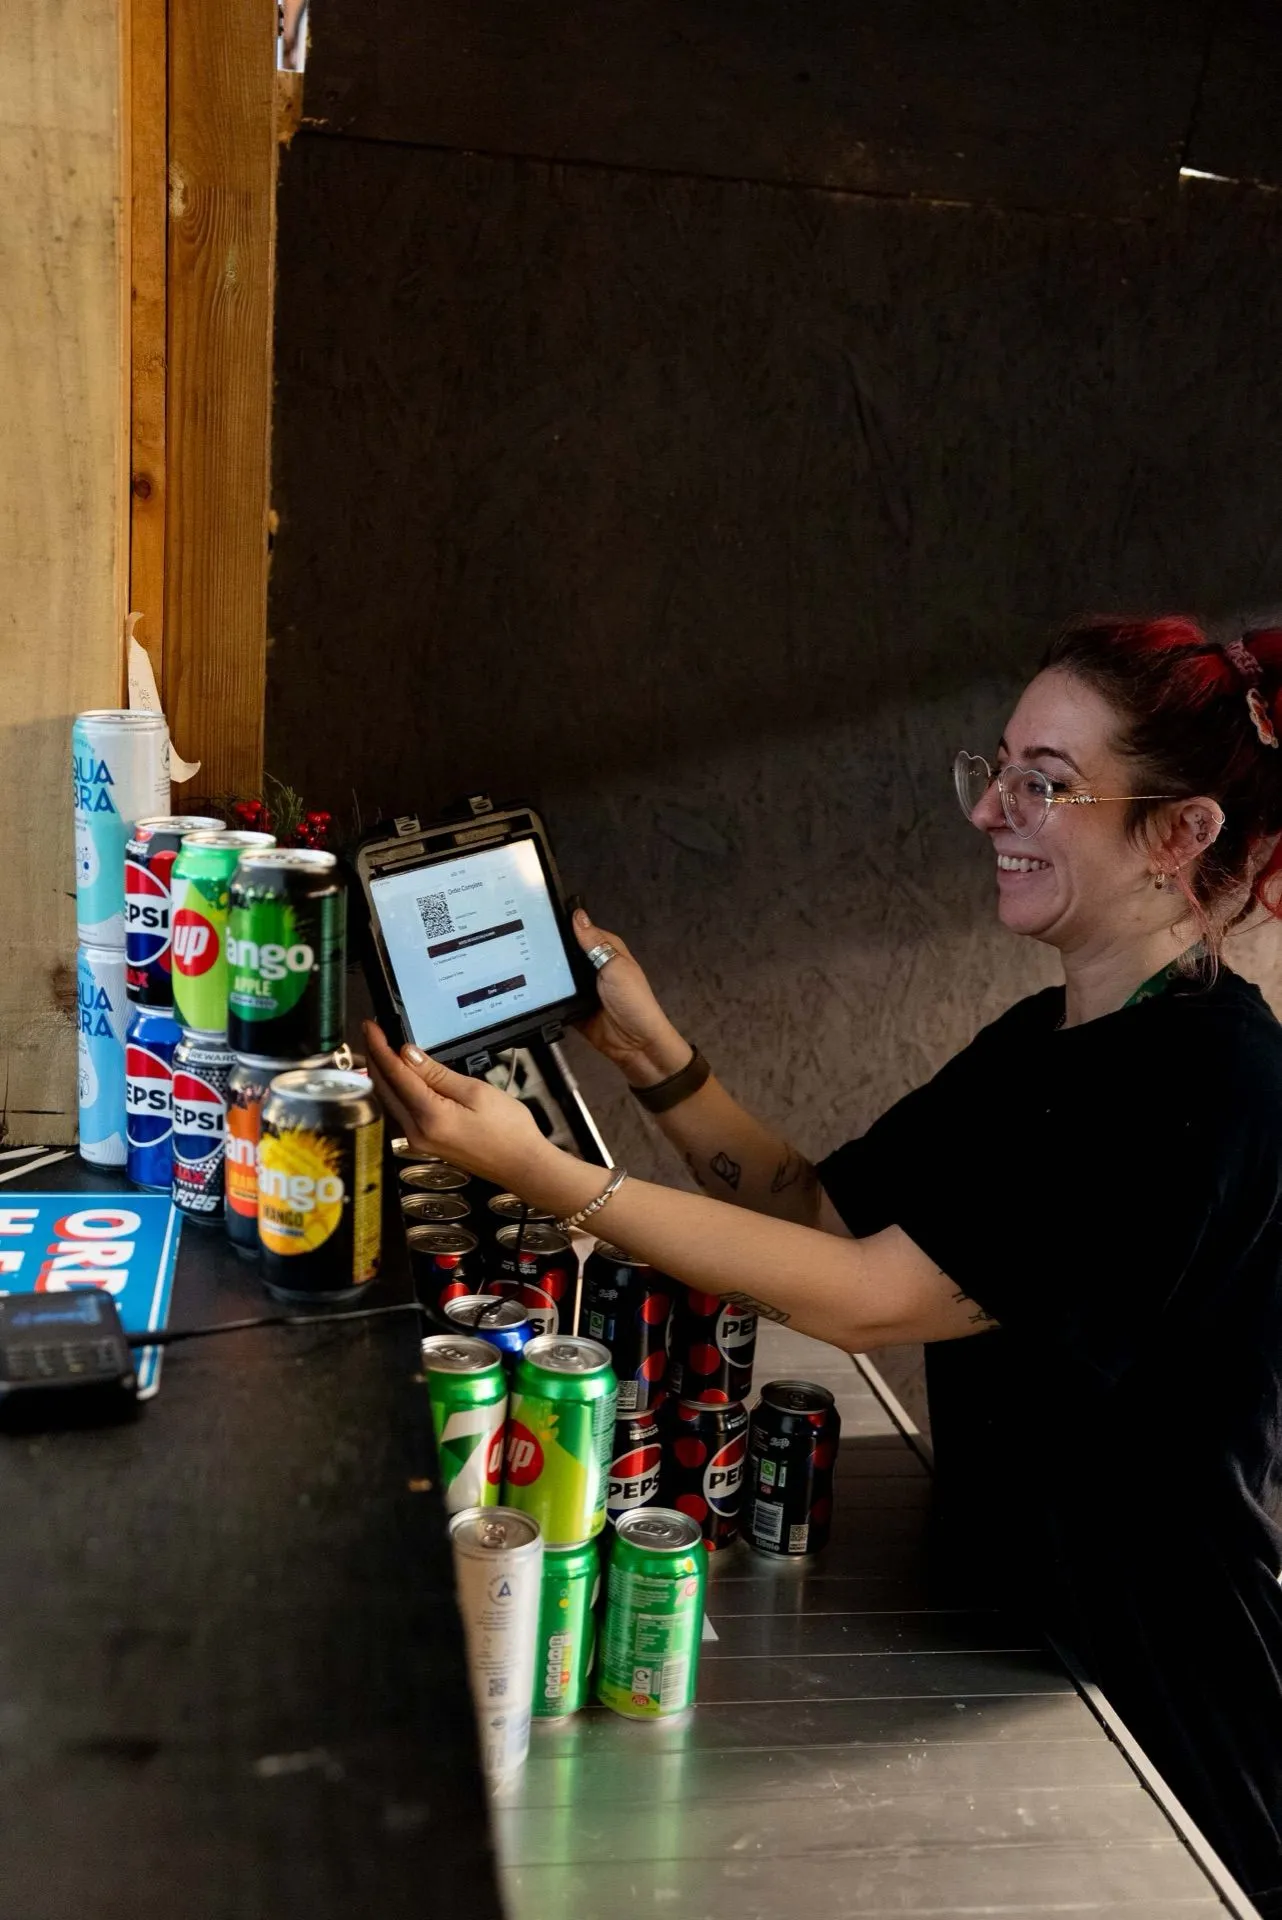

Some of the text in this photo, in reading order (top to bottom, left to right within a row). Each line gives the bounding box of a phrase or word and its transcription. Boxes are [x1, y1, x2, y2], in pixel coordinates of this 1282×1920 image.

[125, 901, 169, 929] PSI
[173, 925, 209, 966] up
[225, 932, 320, 981] ango.
[234, 975, 272, 997] APPLE
[256, 1164, 351, 1212] ango.
[263, 1204, 305, 1227] MANGO
[35, 1208, 142, 1298] ORD
